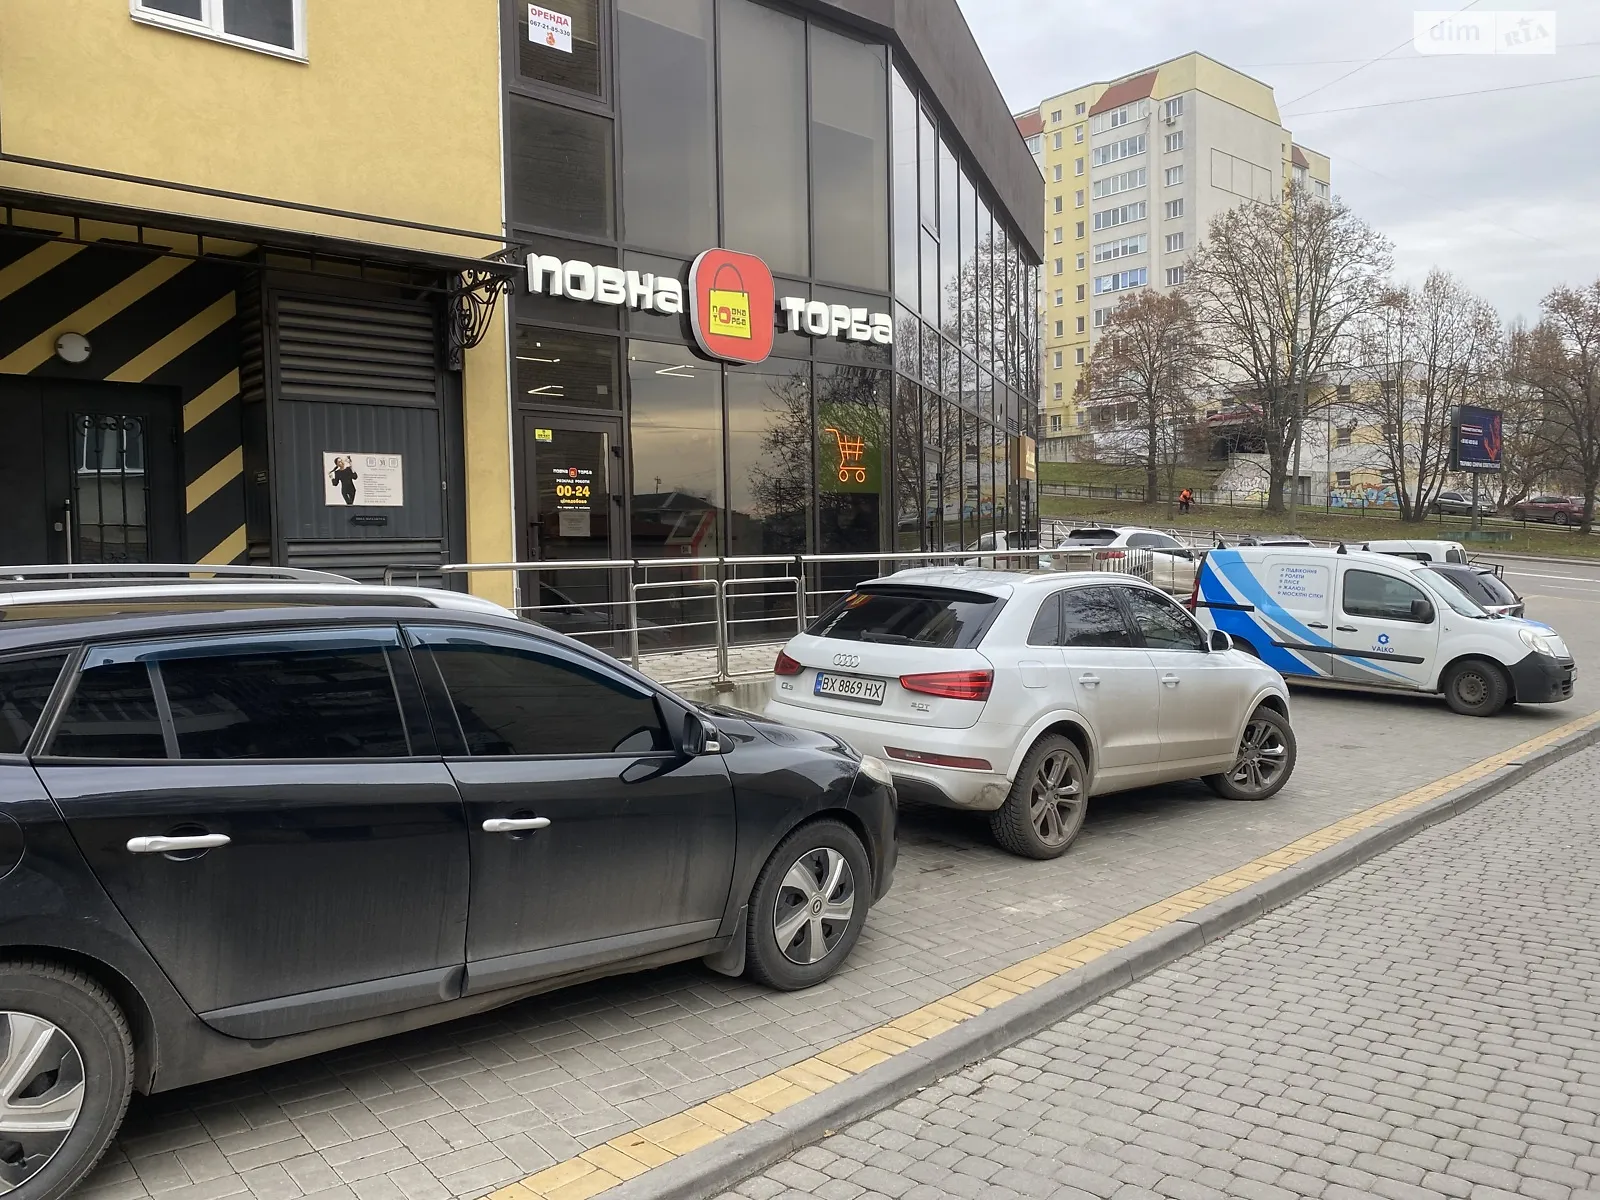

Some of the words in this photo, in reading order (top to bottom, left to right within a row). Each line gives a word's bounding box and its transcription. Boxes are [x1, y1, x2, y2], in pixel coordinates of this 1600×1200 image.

[530, 8, 569, 27] ОРЕНДА
[556, 485, 590, 497] 00-24
[1371, 645, 1395, 653] VALKO
[822, 677, 837, 691] BX
[838, 679, 863, 695] 8869
[864, 682, 882, 698] HX
